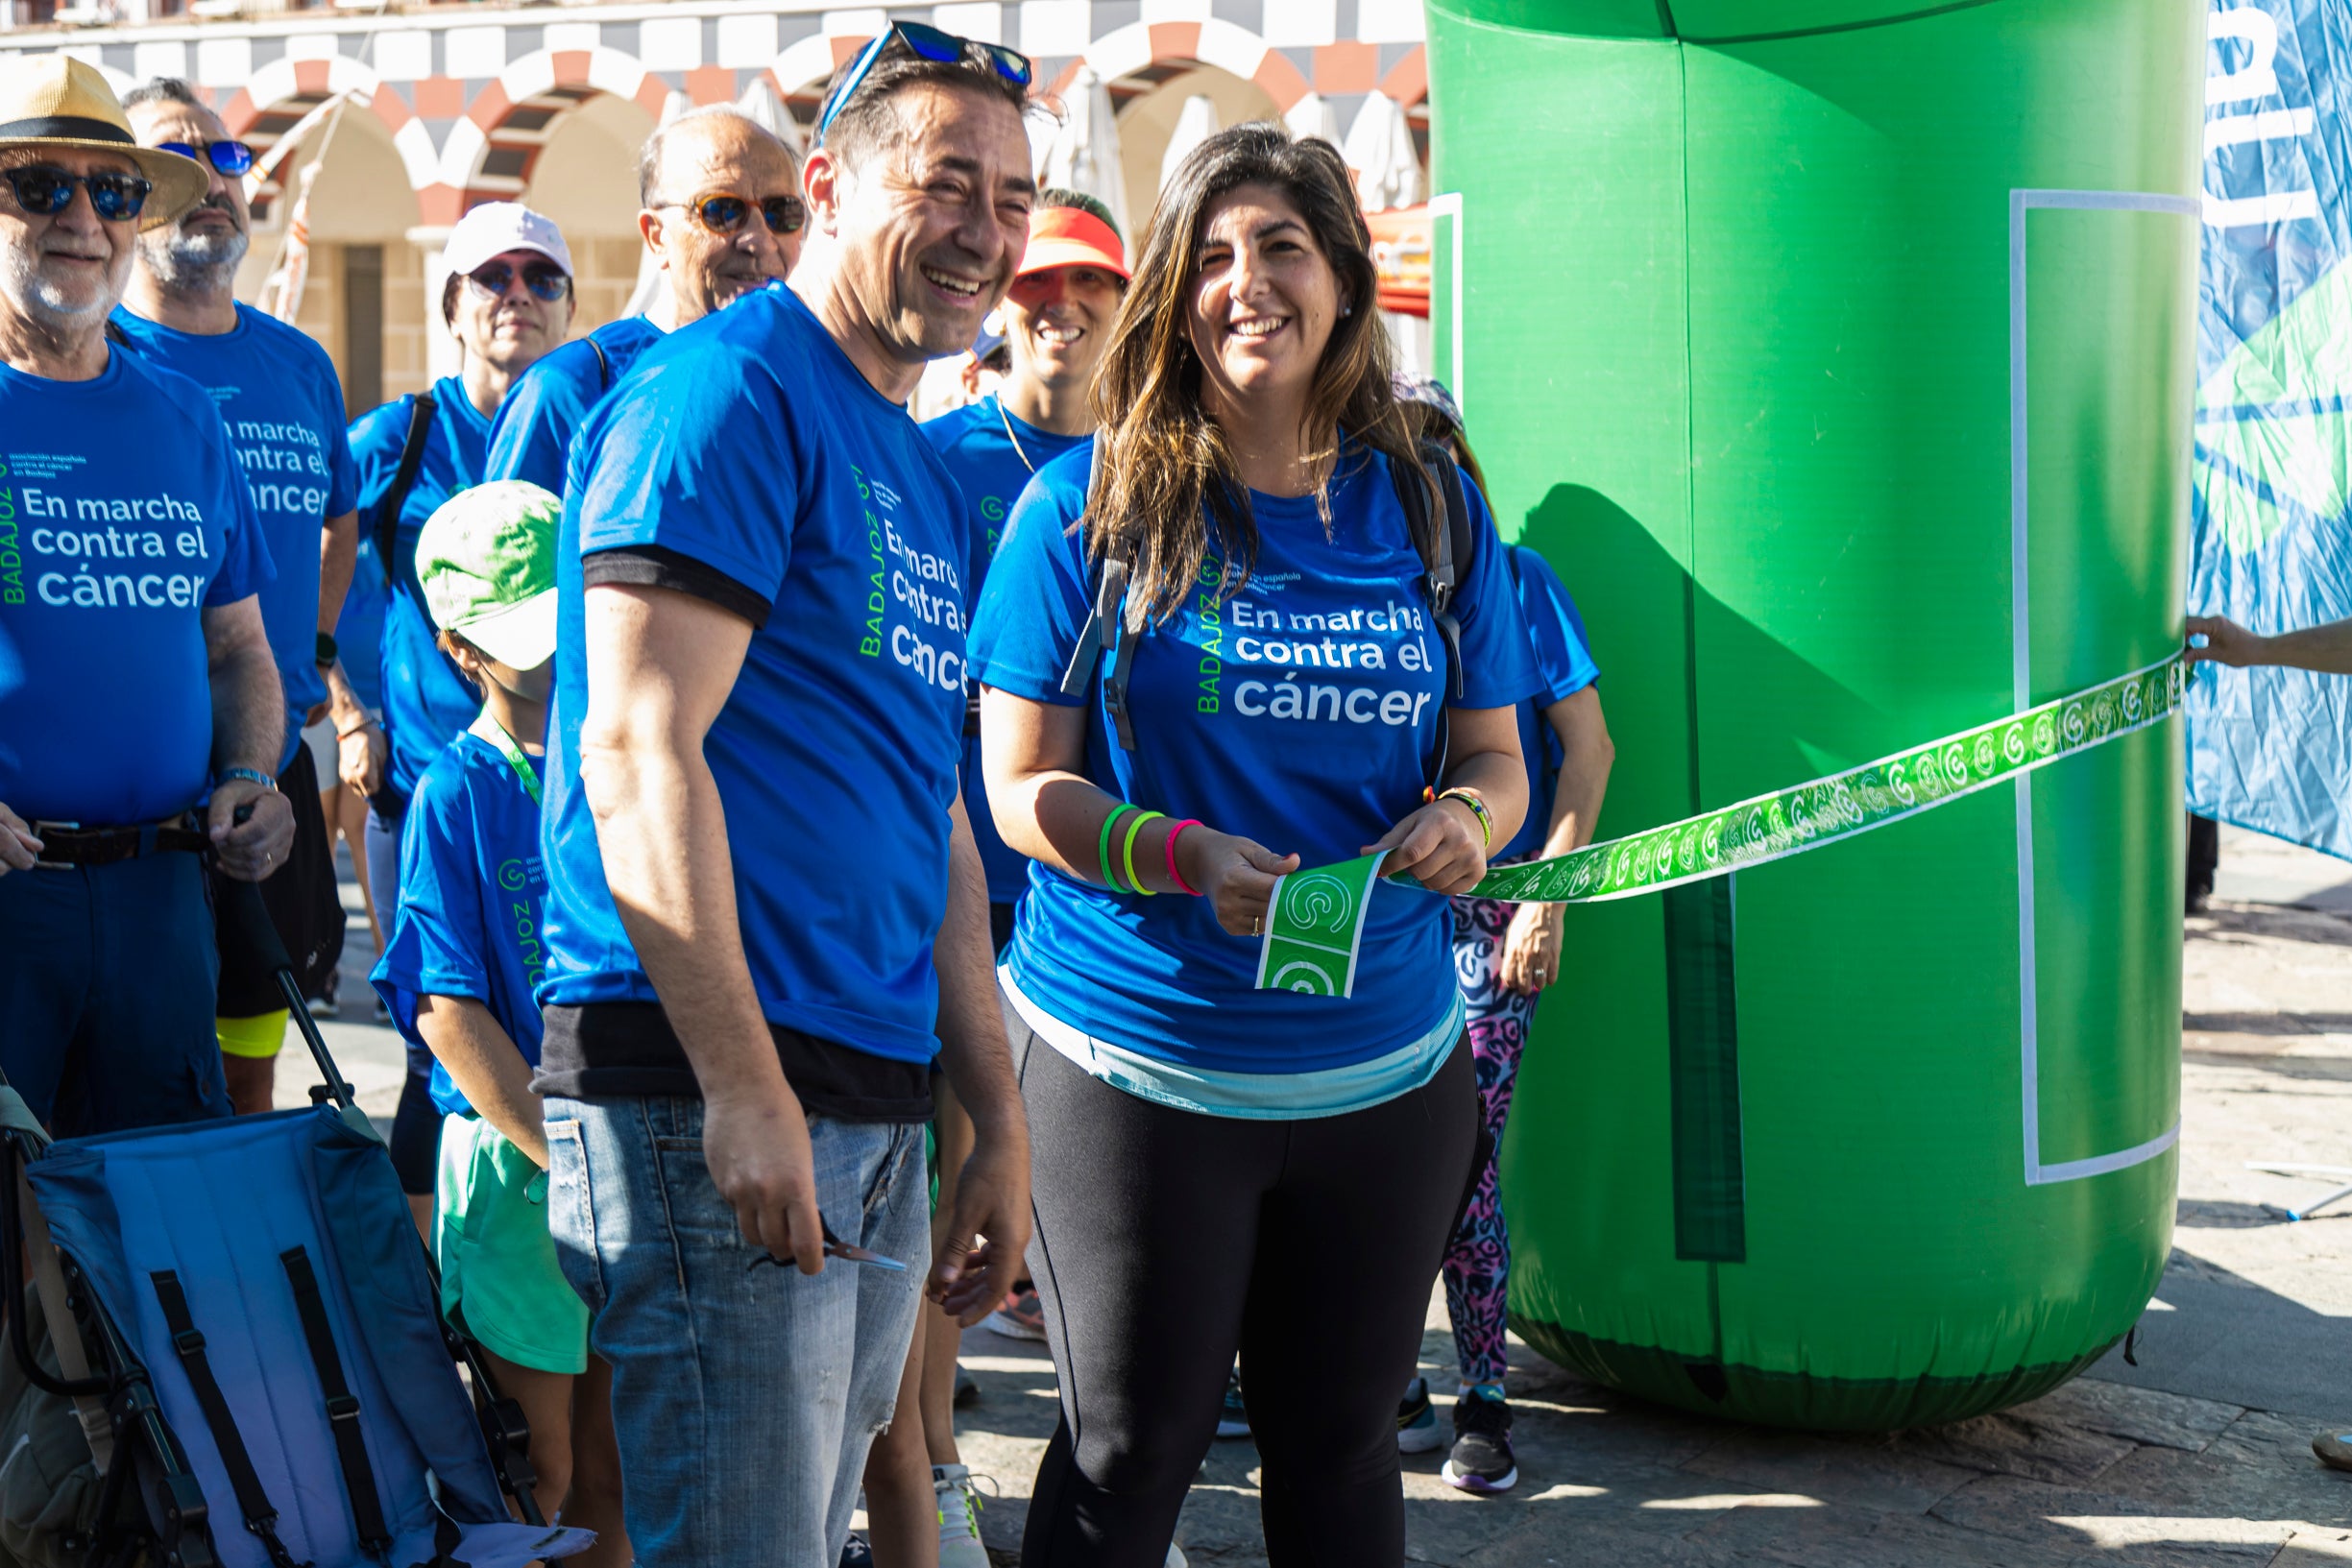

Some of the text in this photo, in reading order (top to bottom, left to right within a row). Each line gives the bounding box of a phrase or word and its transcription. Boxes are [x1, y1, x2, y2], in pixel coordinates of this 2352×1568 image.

[237, 421, 320, 447] marcha
[234, 444, 328, 476] ntra el
[22, 488, 203, 522] En marcha
[248, 474, 328, 516] ncer
[32, 525, 208, 559] contra el
[37, 564, 205, 607] cáncer
[860, 509, 886, 659] BADAJOZ
[1232, 599, 1424, 633] En marcha
[1198, 593, 1222, 713] BADAJOZ
[1235, 635, 1433, 672] contra el
[1234, 671, 1432, 727] cáncer
